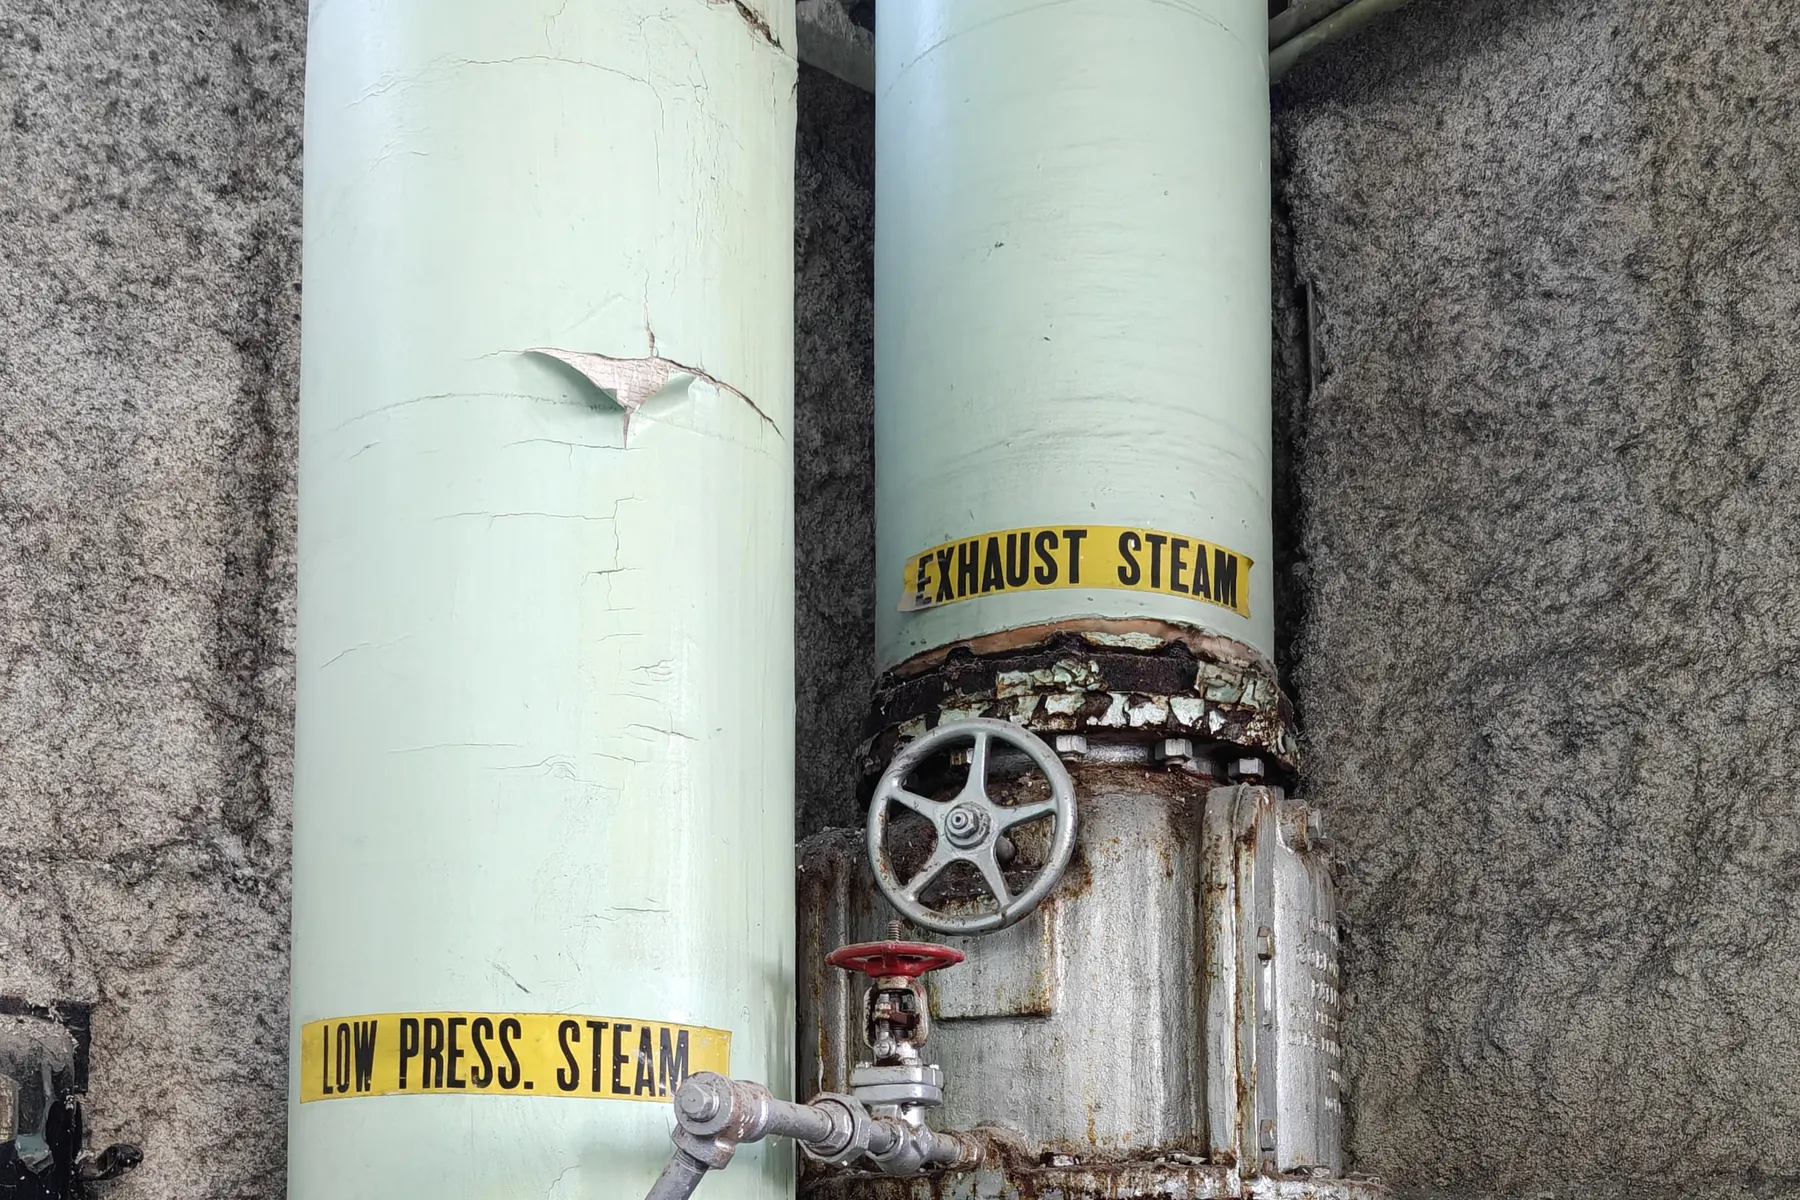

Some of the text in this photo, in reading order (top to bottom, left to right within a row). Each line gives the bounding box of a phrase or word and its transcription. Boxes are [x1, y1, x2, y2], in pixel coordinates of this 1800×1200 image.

[914, 530, 1239, 610] EXHAUST STEAM
[322, 1017, 690, 1098] LOW PRESS. STEAM
